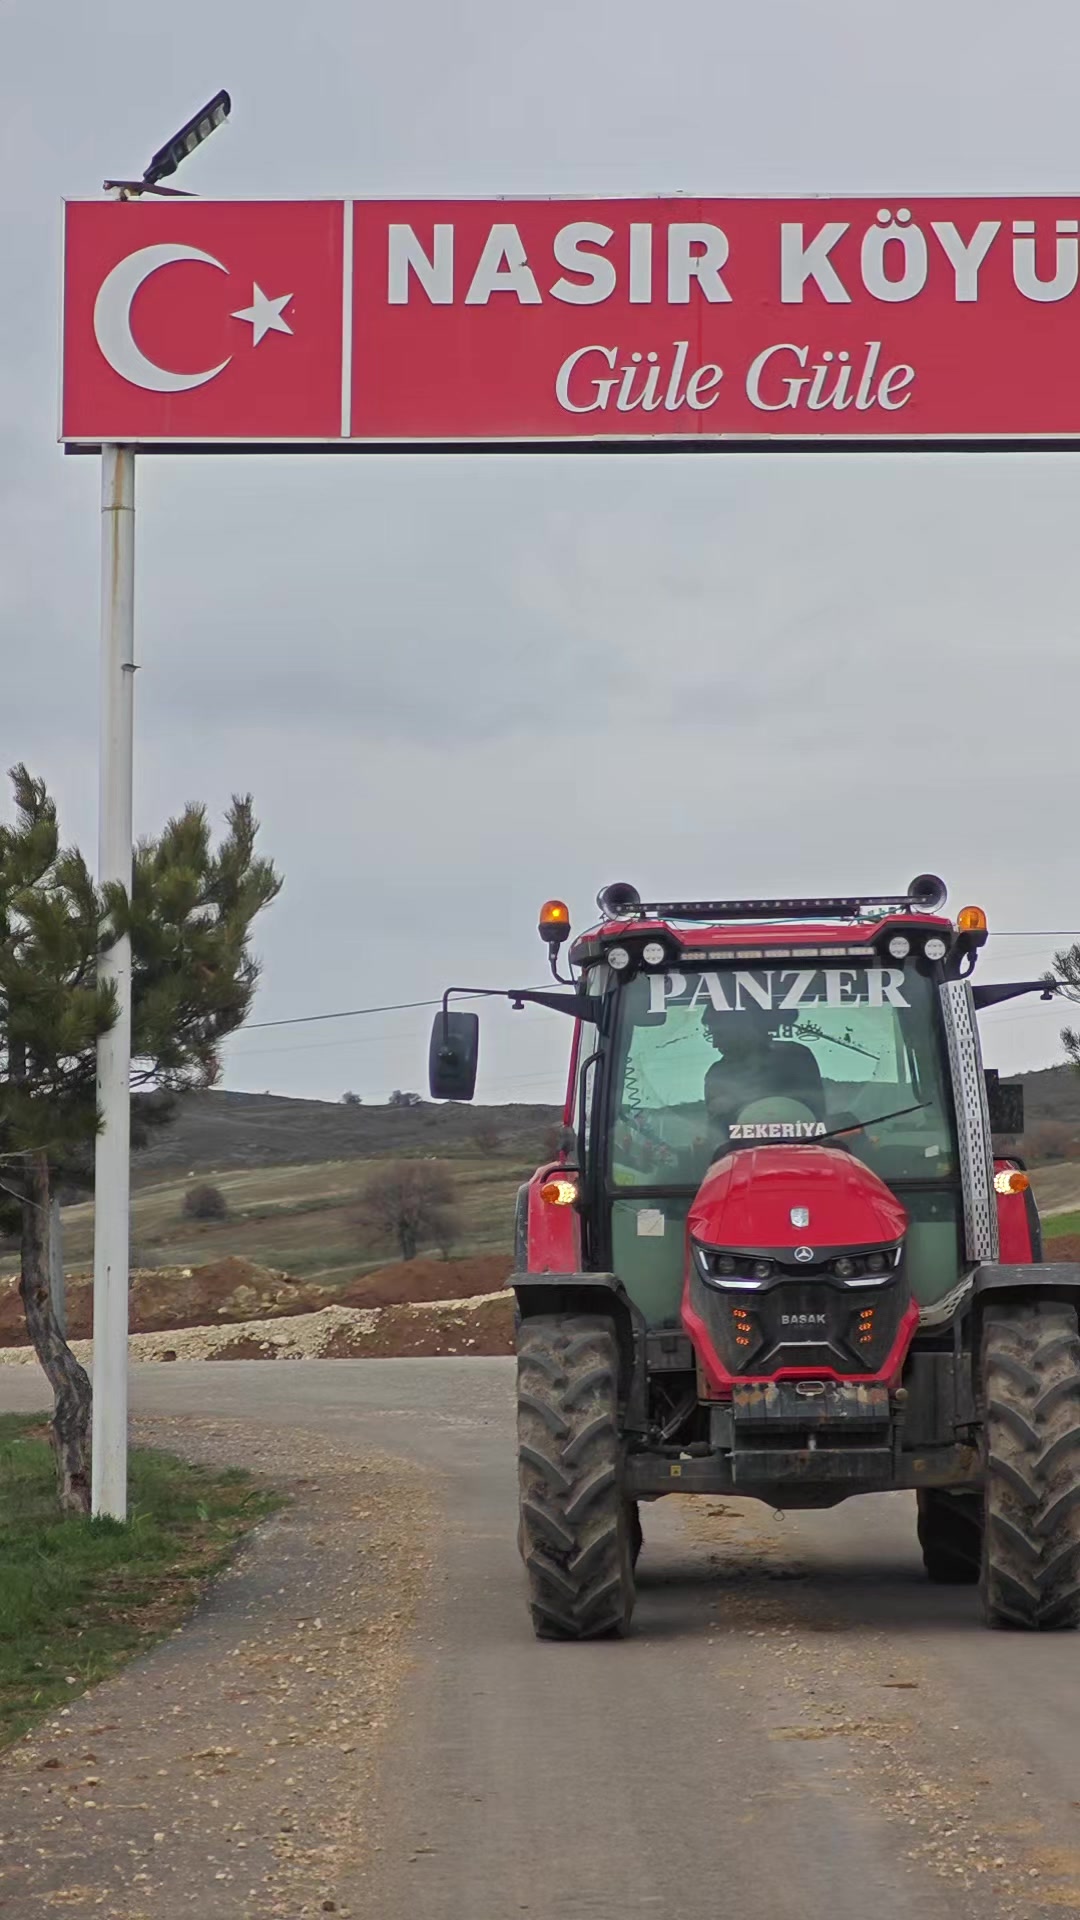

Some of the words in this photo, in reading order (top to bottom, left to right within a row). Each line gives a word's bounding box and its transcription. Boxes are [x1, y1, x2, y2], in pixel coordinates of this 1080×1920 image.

[388, 221, 733, 305] NASIR
[780, 207, 1079, 303] KÖYÜ
[555, 341, 724, 413] Güle
[745, 341, 915, 412] Güle
[647, 967, 911, 1014] PANZER
[728, 1120, 828, 1139] ZEKERİYA
